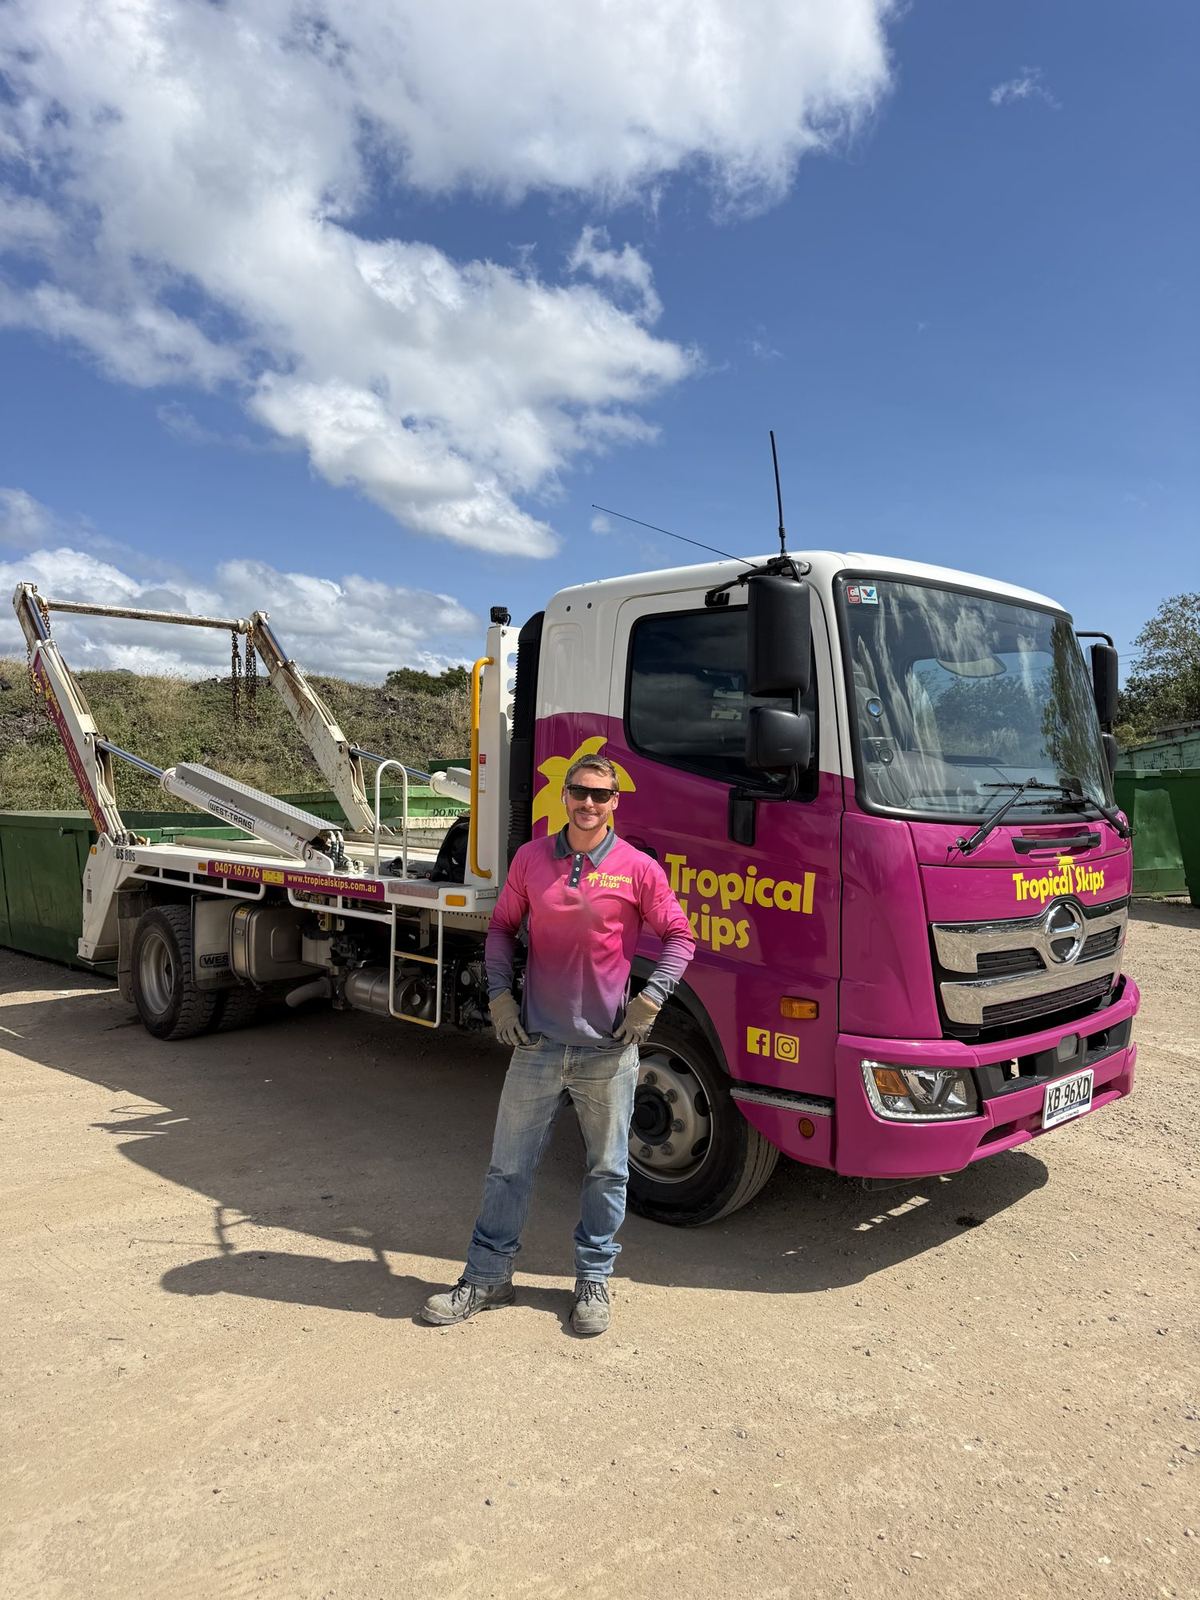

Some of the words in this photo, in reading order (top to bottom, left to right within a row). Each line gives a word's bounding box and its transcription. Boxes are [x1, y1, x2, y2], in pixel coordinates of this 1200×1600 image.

[433, 809, 446, 817] DO
[214, 862, 232, 875] 0407
[233, 864, 246, 877] 167
[246, 866, 260, 879] 776
[601, 872, 633, 884] Tropical
[287, 873, 377, 894] www.tropicalskips.com.au
[600, 879, 620, 889] Skips
[665, 853, 816, 915] Tropical
[1012, 865, 1073, 904] Tropical
[1075, 866, 1105, 896] Skips
[679, 898, 750, 951] kips
[203, 955, 229, 966] WES
